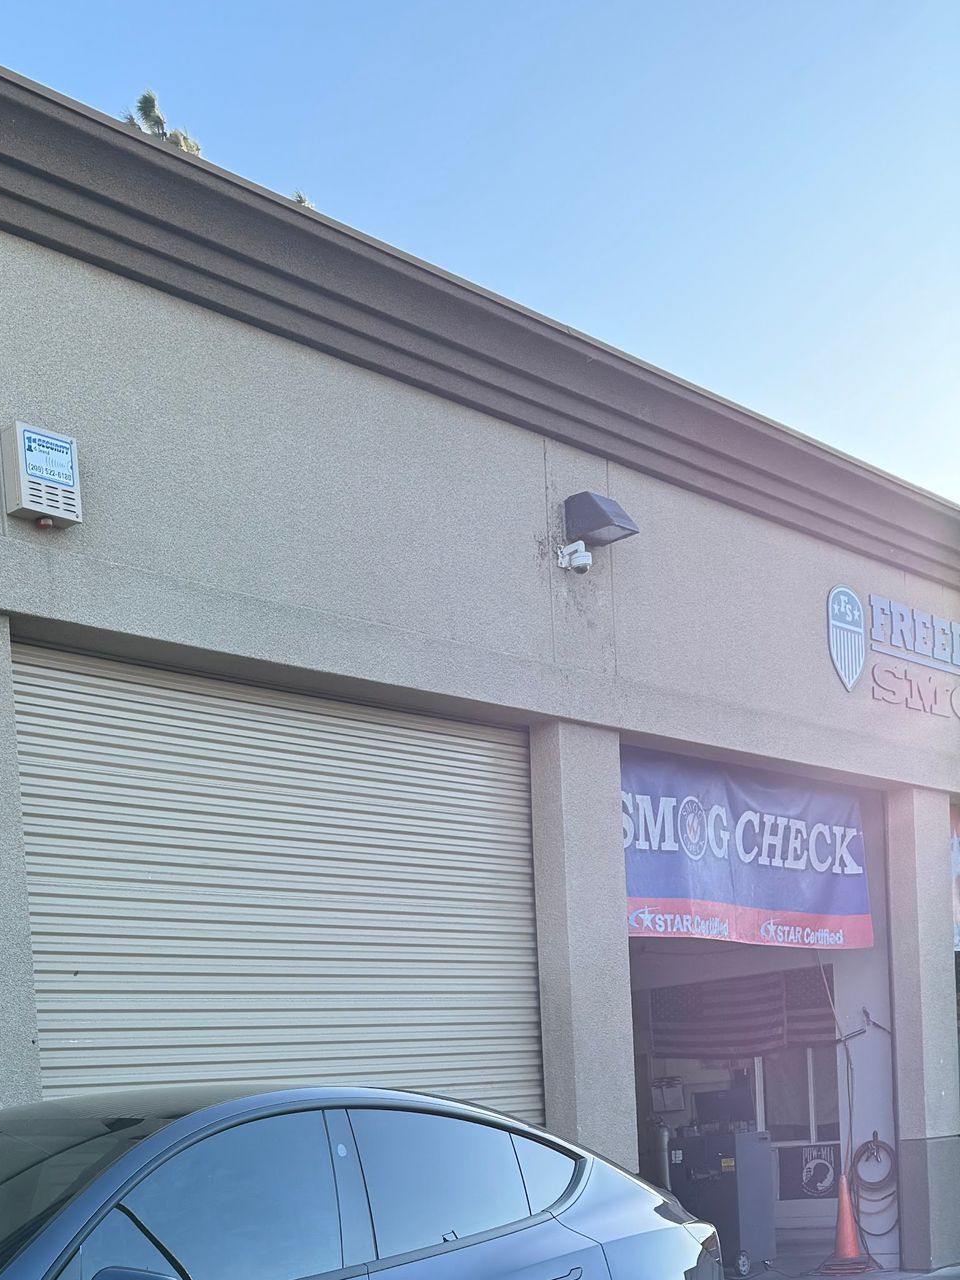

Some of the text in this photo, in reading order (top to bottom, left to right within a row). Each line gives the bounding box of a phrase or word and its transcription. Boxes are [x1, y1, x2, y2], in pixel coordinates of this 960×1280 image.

[735, 810, 863, 875] CHECK
[655, 914, 729, 937] STAR Certified
[776, 926, 844, 944] STAR Certified
